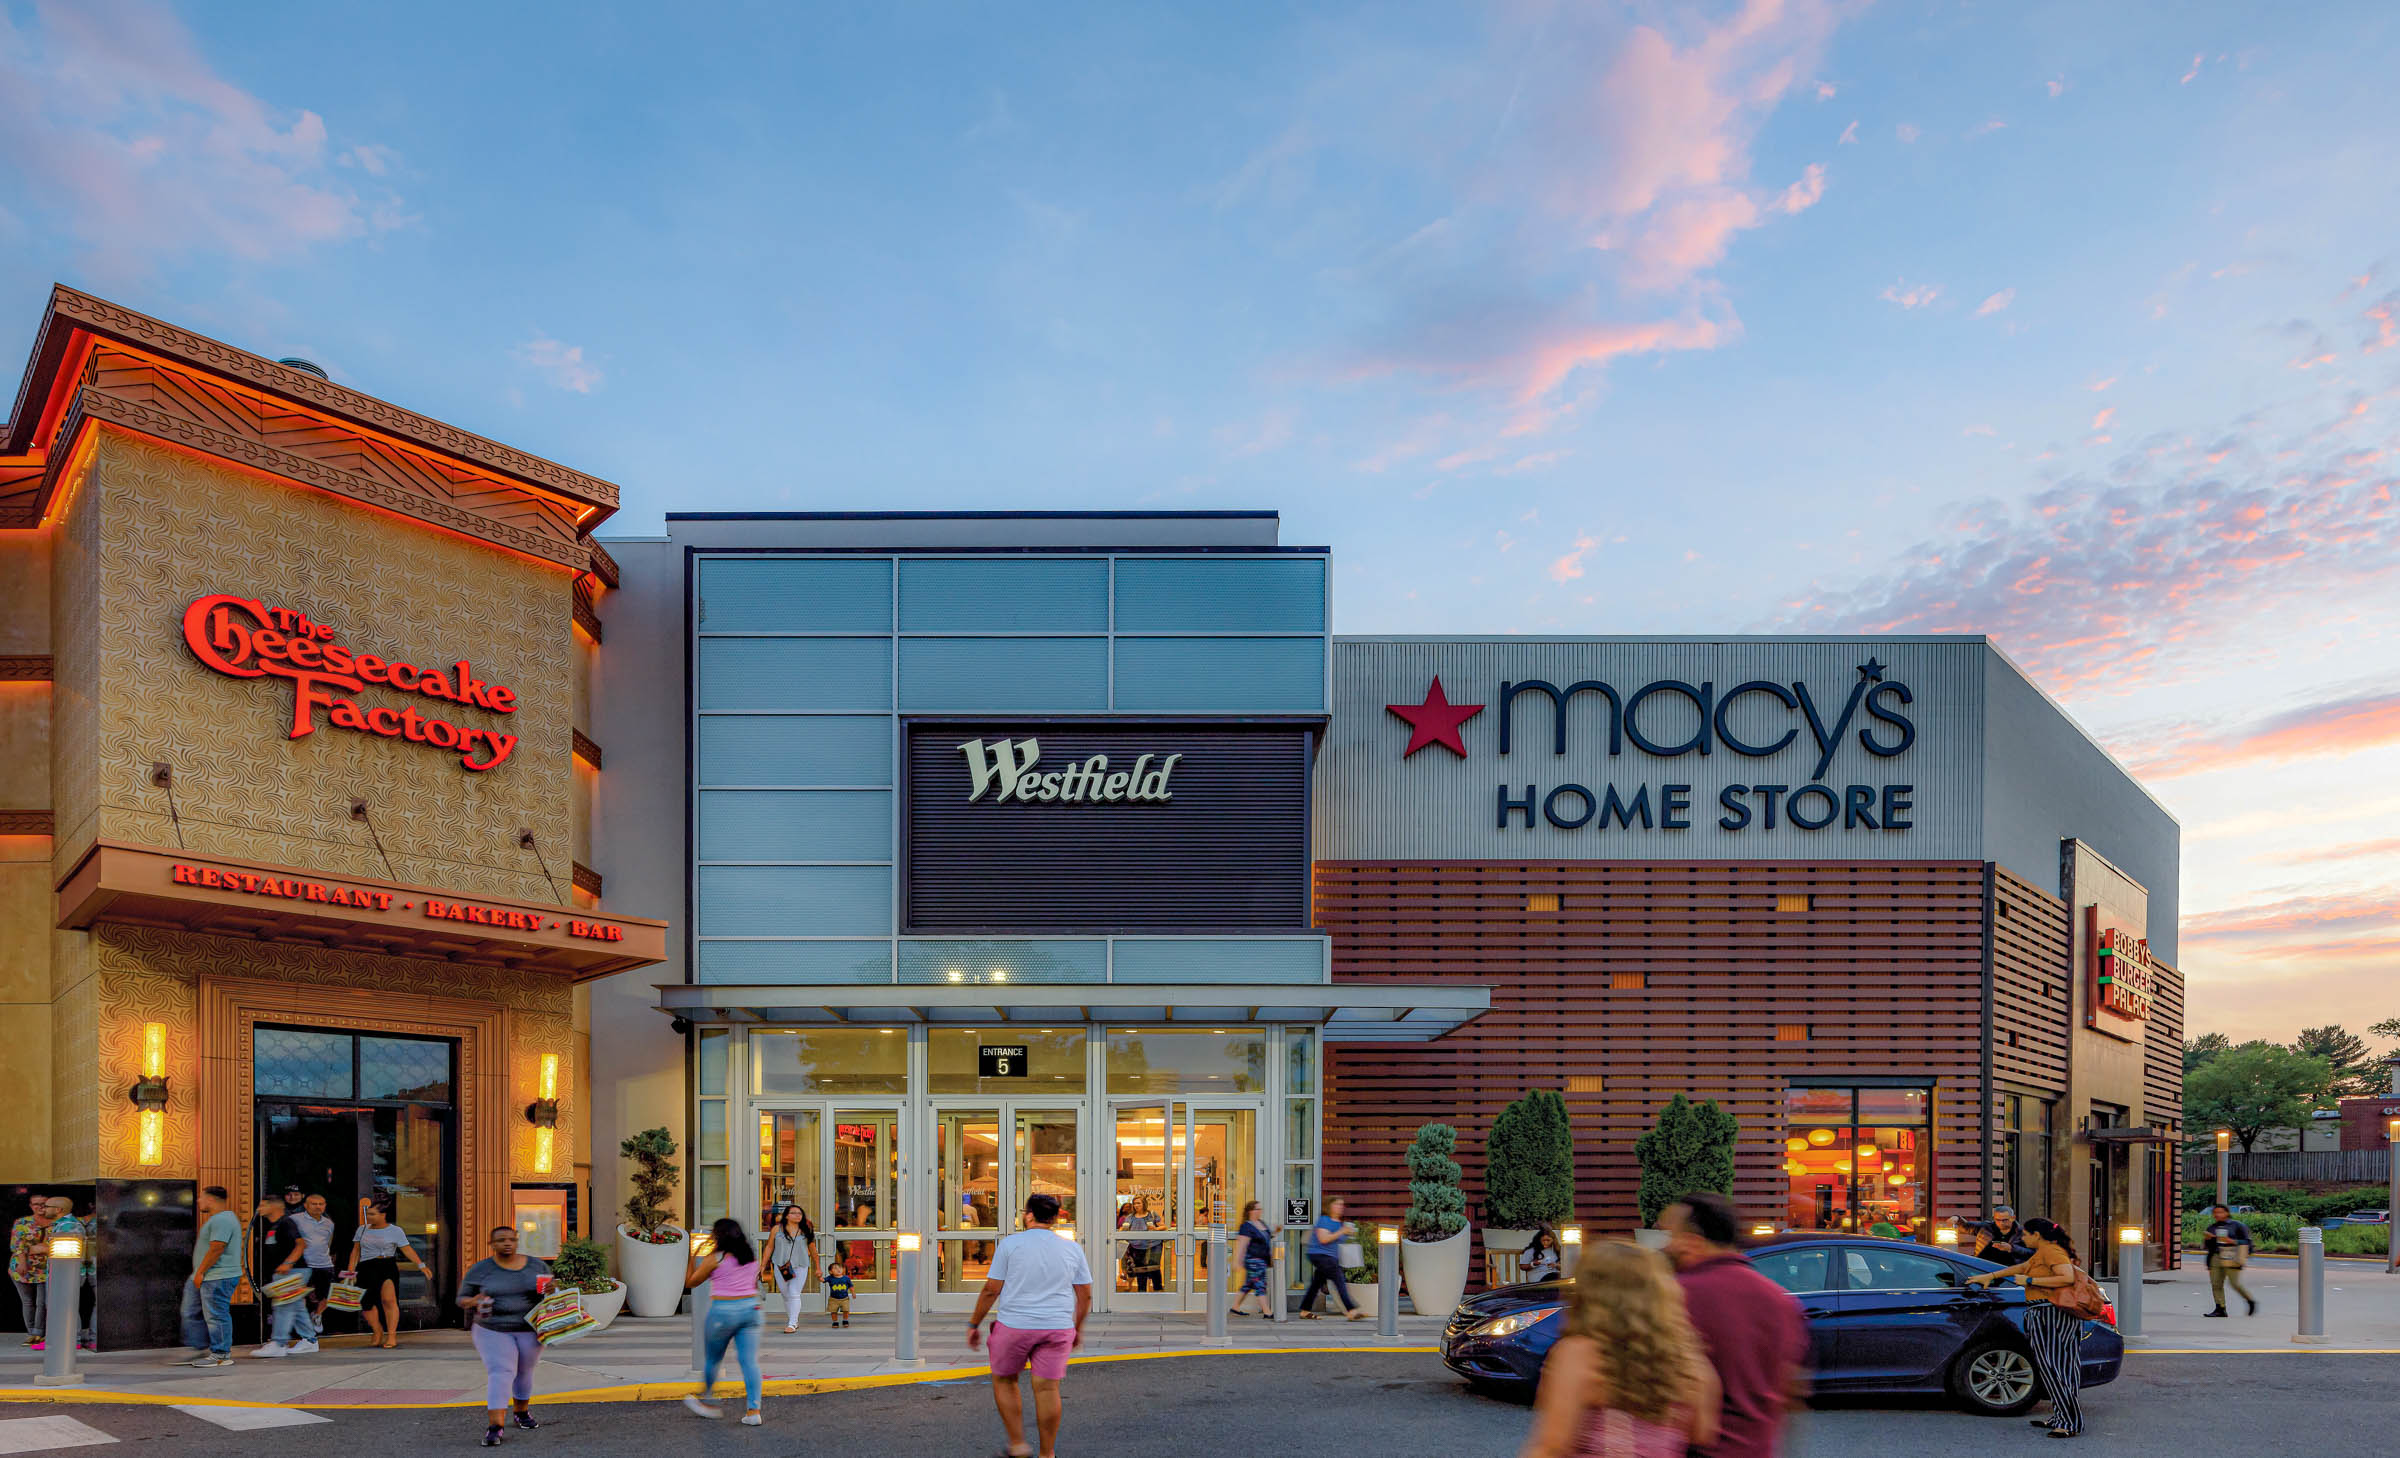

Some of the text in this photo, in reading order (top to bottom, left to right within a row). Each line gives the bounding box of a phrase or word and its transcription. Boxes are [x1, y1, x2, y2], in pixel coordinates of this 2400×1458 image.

[271, 606, 335, 641] The
[183, 594, 519, 714] Cheesecake
[257, 658, 519, 772] Factory
[1499, 656, 1917, 781] macy's
[956, 737, 1183, 804] Westfield
[1497, 782, 1914, 830] HOME STORE
[172, 863, 624, 942] RESTAURANT BAKERY BAR
[2113, 928, 2152, 970] BOBBY'S
[2113, 955, 2152, 995] BURGER
[2113, 984, 2151, 1021] PALACE
[982, 1047, 1023, 1056] ENTRANCE
[998, 1058, 1009, 1075] 5
